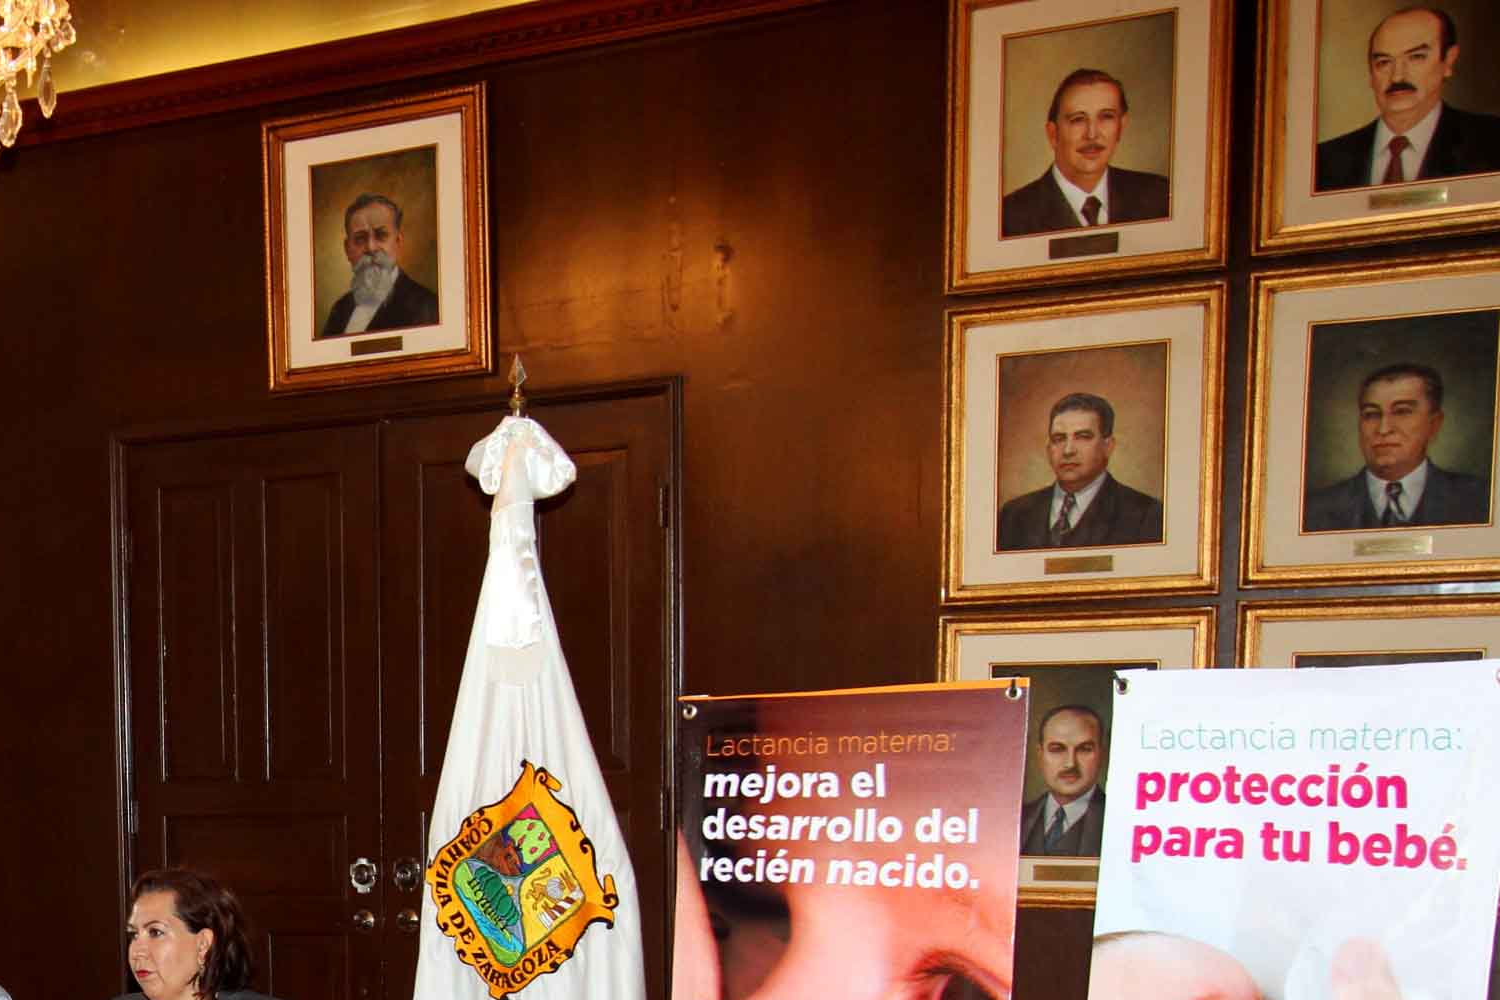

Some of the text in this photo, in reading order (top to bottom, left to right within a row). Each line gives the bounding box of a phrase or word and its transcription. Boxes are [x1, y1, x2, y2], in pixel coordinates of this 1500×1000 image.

[707, 729, 956, 756] Lactancia materna:
[1140, 722, 1463, 751] Lactancia materna:
[703, 763, 887, 804] mejora el
[1135, 762, 1408, 810] protección
[702, 807, 980, 844] desarrollo del
[1131, 821, 1467, 871] para tu bebé.
[699, 849, 980, 890] recién nacido.
[450, 911, 475, 945] DE
[471, 940, 561, 989] ZARAGOZA
